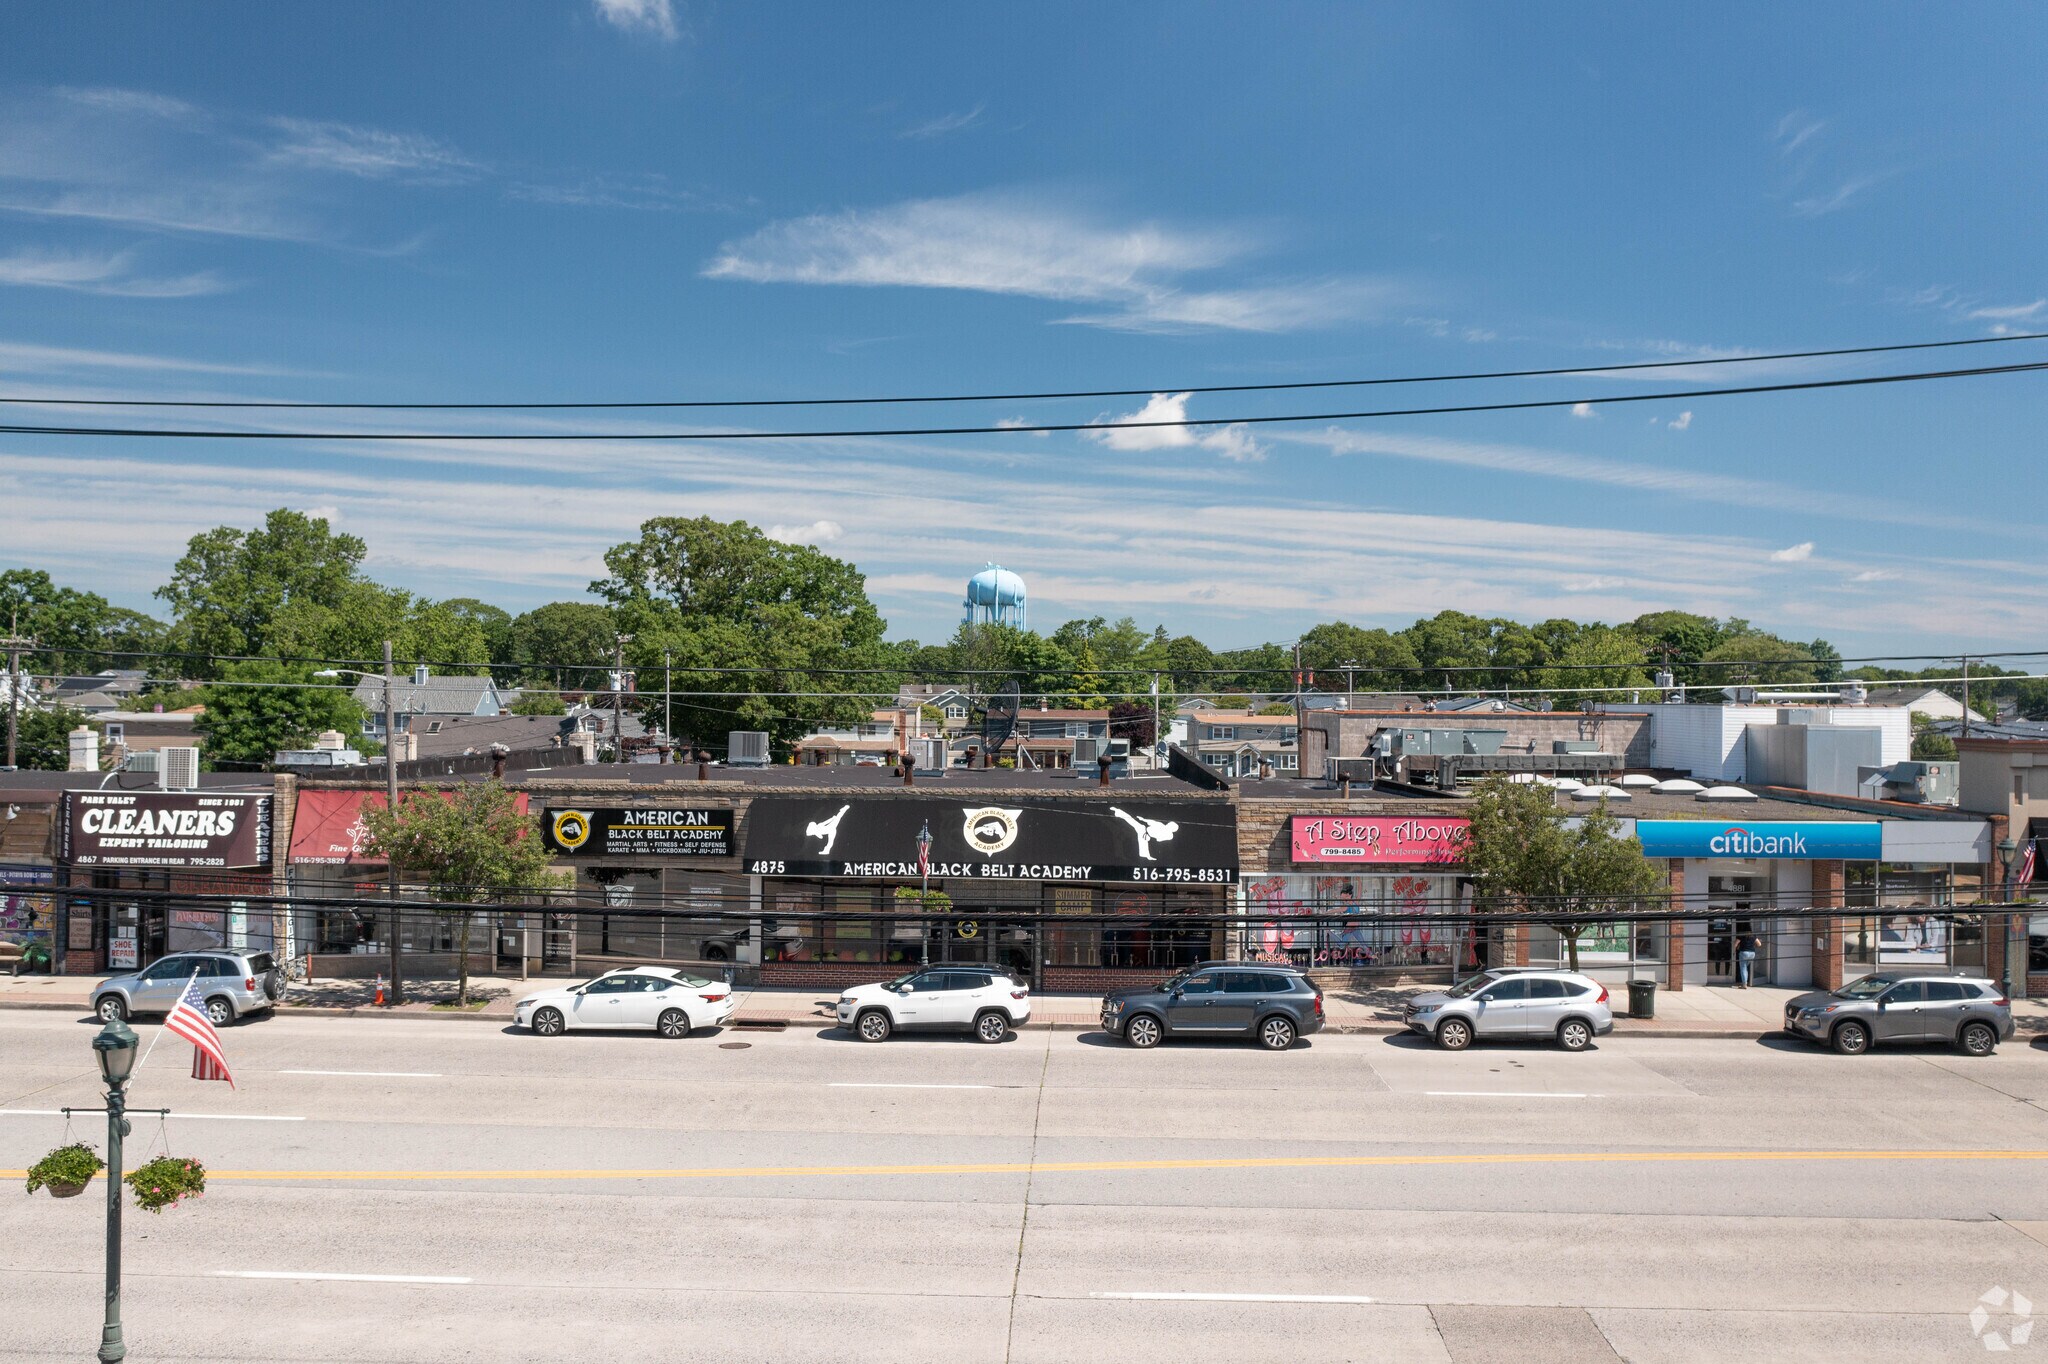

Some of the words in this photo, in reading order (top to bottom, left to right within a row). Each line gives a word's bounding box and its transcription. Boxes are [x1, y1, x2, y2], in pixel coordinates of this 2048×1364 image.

[80, 796, 105, 804] PARK
[81, 808, 236, 836] CLEANERS
[623, 811, 708, 825] AMERICAN
[966, 810, 989, 830] AMERICAN
[255, 798, 270, 862] CLEANERS
[608, 830, 643, 839] BLACK
[647, 830, 670, 839] BELT
[673, 830, 723, 840] ACADEMY
[1304, 820, 1324, 844] A
[1330, 820, 1381, 845] Step
[99, 838, 144, 848] EXPERT
[147, 839, 209, 849] TAILORING
[974, 841, 1004, 850] ACADEMY
[1710, 829, 1806, 854] citibank
[329, 844, 348, 852] Fine
[77, 856, 97, 864] 4867
[751, 860, 785, 874] 4875
[843, 862, 917, 876] AMERICAN
[980, 864, 1015, 877] BELT
[1019, 865, 1092, 879] ACADEMY
[1132, 867, 1231, 882] 516-795-8531
[1056, 890, 1091, 900] SUMMER
[1060, 901, 1087, 911] CAMP
